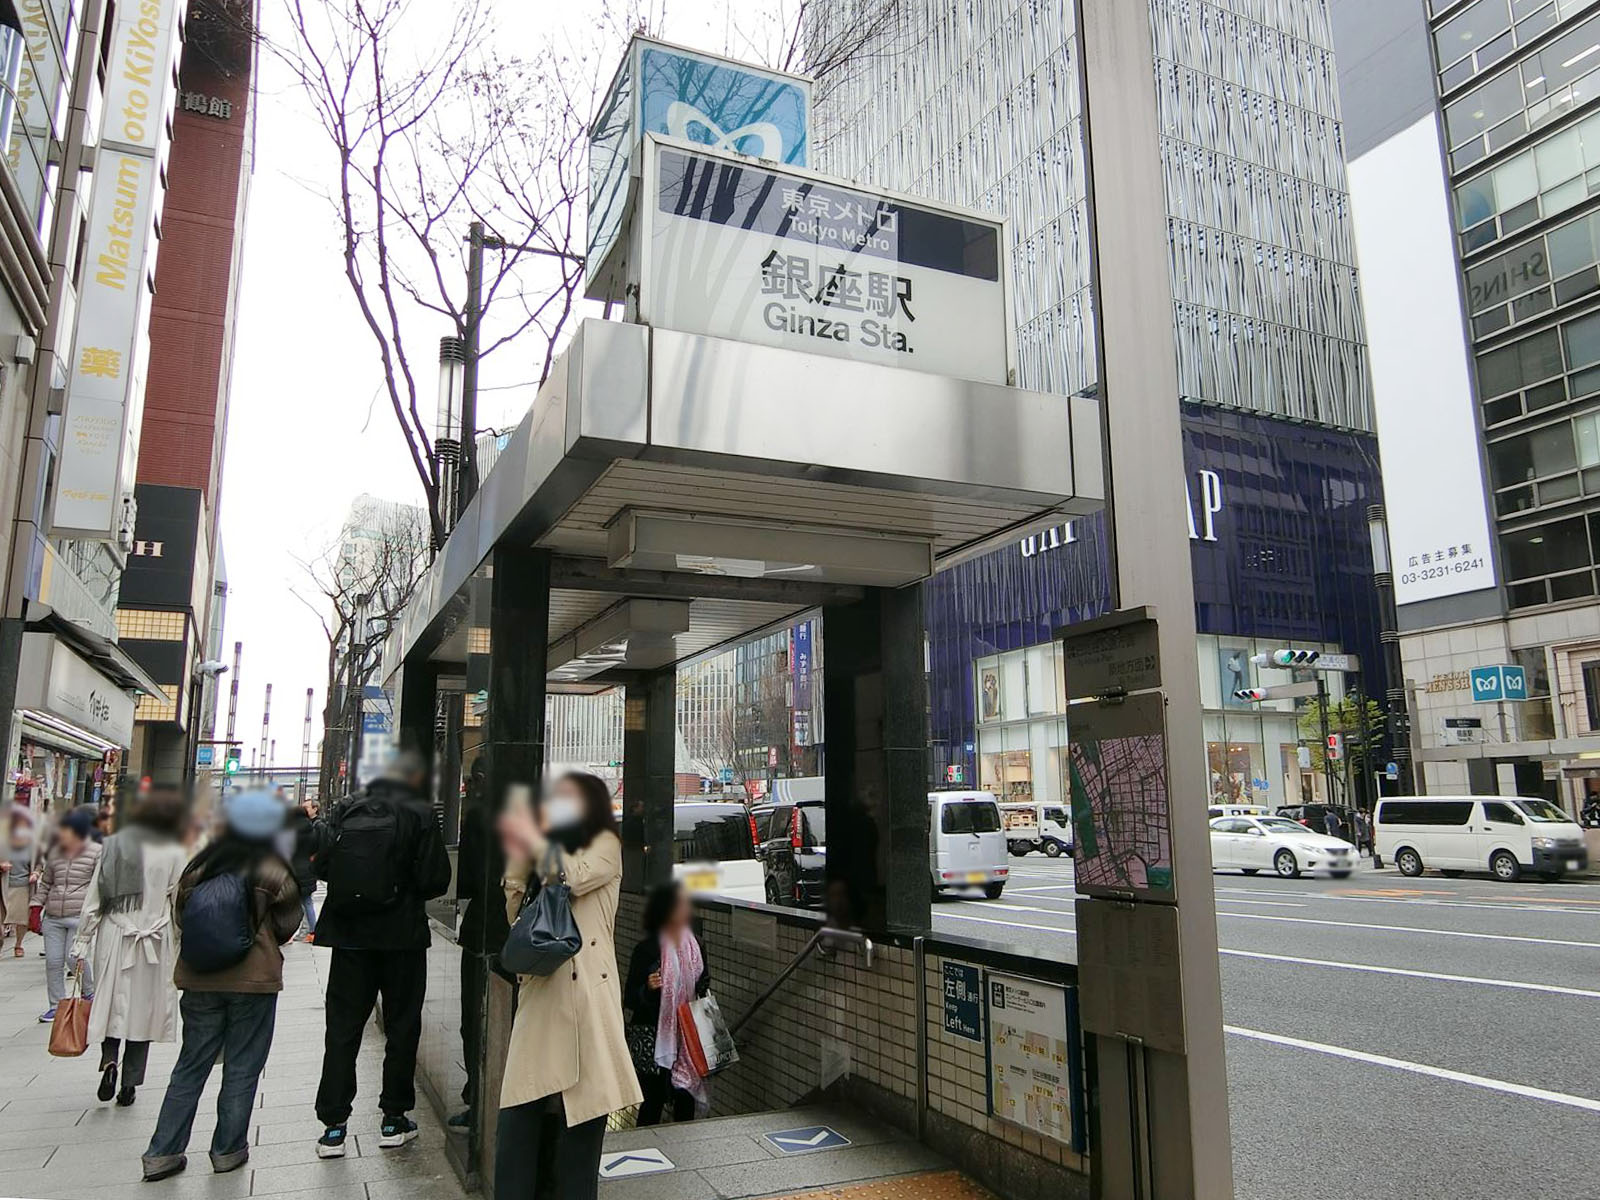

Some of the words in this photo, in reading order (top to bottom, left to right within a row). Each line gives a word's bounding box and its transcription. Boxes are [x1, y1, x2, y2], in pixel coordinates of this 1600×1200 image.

[123, 0, 161, 87] KiYos
[782, 188, 897, 232] 東京メトロ
[790, 218, 838, 242] Tokyo
[841, 228, 890, 252] Metro
[760, 249, 916, 322] 銀座駅
[762, 301, 850, 342] Ginza
[859, 319, 914, 354] Sta.
[1401, 558, 1485, 585] 03-3231-6241
[1407, 543, 1473, 568] 広告主募集
[945, 1013, 962, 1031] Left
